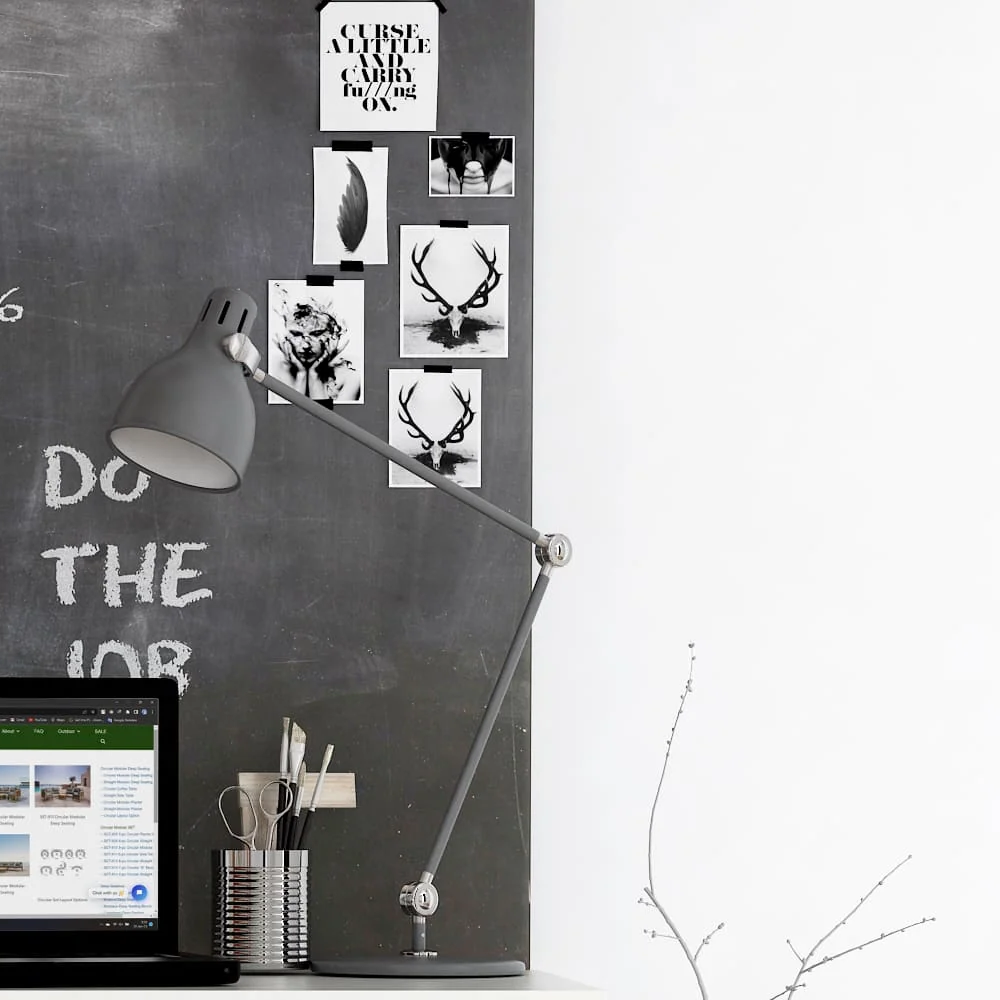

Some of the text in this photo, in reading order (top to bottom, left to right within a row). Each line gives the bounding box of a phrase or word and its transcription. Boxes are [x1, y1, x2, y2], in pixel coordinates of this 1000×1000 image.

[340, 24, 419, 39] CURSE
[323, 39, 431, 53] A LITTLE
[354, 53, 404, 68] AND
[341, 68, 416, 83] CARRY
[362, 97, 397, 112] ON.
[43, 444, 151, 510] DO
[40, 542, 213, 608] THE
